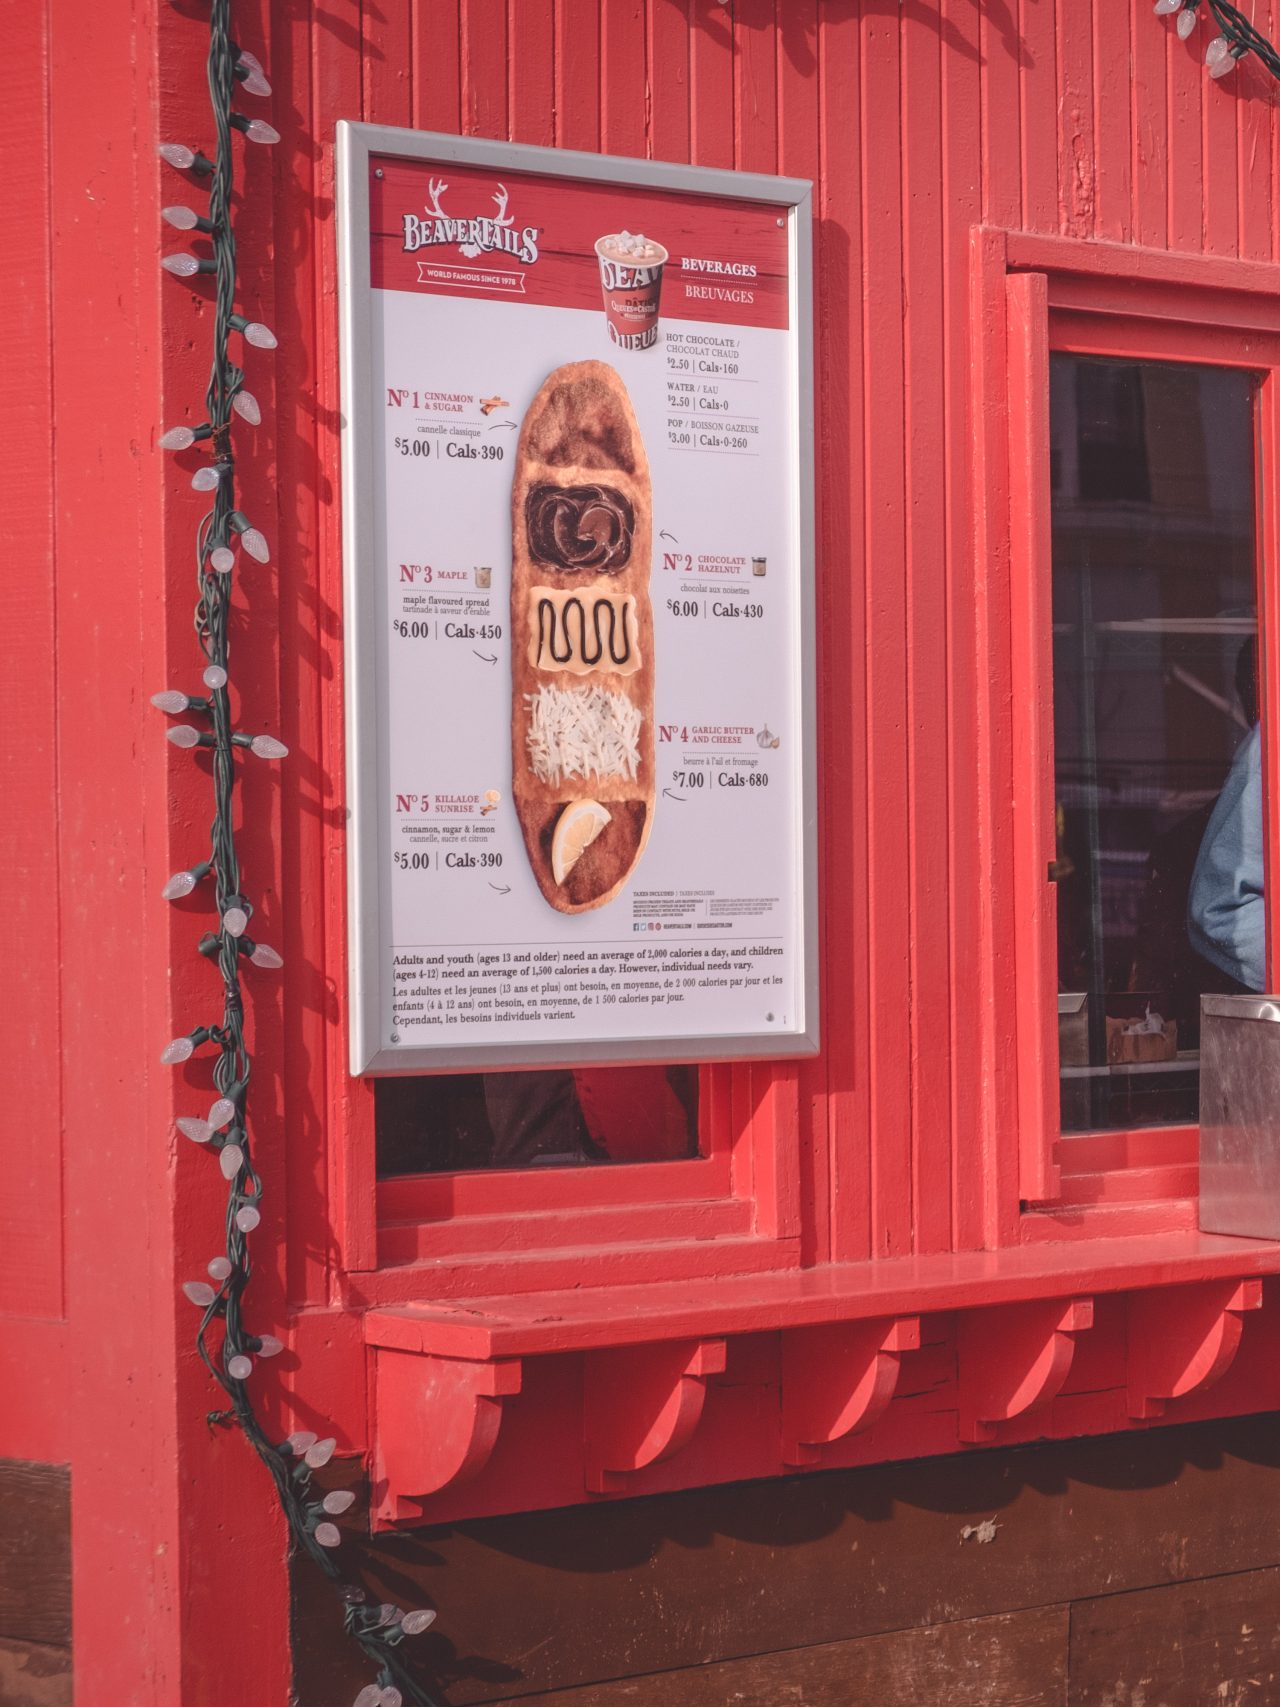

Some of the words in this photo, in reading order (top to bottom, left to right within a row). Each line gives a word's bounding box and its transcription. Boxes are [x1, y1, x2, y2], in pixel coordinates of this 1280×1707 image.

[681, 257, 757, 277] BEVERAGES
[427, 269, 452, 279] WORLD
[452, 272, 480, 282] FAMOUS
[481, 275, 500, 284] SINCE
[501, 278, 516, 286] 1978
[685, 284, 754, 304] BREUVAGES
[666, 333, 684, 342] HOT
[686, 336, 735, 348] CHOCOLATE
[666, 344, 710, 356] CHOCOLAT
[712, 349, 740, 359] CHAUD
[667, 356, 689, 370] $2.50
[667, 382, 695, 392] WATER
[703, 385, 718, 394] EAU
[412, 391, 420, 408] 1
[424, 392, 474, 404] CINNAMON
[668, 394, 690, 407] $2.50
[424, 402, 430, 410] &
[432, 402, 464, 412] SUGAR
[417, 424, 447, 434] cannelle
[448, 426, 481, 439] classique
[668, 418, 683, 428] POP
[691, 420, 723, 430] BOISSON
[726, 424, 759, 434] GAZEUSE
[668, 432, 690, 444] $3.00
[394, 436, 430, 457] $5.00
[685, 554, 692, 571] 2
[698, 555, 746, 565] CHOCOLATE
[424, 566, 432, 584] 3
[437, 571, 468, 580] MAPLE
[698, 564, 741, 574] HAZELNUT
[680, 583, 708, 593] chocolat
[709, 586, 721, 594] aux
[722, 587, 750, 595] noisettes
[403, 596, 426, 606] maple
[428, 596, 463, 606] flavoured
[465, 598, 490, 609] spread
[666, 598, 699, 617] $6.00
[402, 606, 432, 614] tartinade
[440, 608, 462, 616] saveur
[393, 619, 429, 638] $6.00
[680, 726, 688, 742] 4
[692, 726, 720, 734] GARLIC
[724, 726, 754, 735] BUTTER
[692, 736, 710, 744] AND
[711, 736, 742, 744] CHEESE
[683, 756, 705, 766] beurre
[732, 757, 759, 768] fromage
[672, 770, 704, 788] $7.00
[420, 794, 429, 812] 5
[435, 795, 480, 804] KILLALOE
[435, 804, 474, 813] SUNRISE
[402, 826, 440, 834] cinnamon,
[442, 826, 461, 836] sugar
[464, 826, 470, 834] &
[472, 825, 496, 834] lemon
[409, 834, 440, 844] cannelle,
[394, 850, 430, 870] $5.00
[392, 955, 424, 966] Adults
[426, 954, 444, 964] and
[447, 954, 474, 966] youth
[476, 953, 500, 965] (ages
[502, 953, 510, 962] 13
[514, 952, 530, 962] and
[533, 951, 560, 963] older)
[562, 951, 585, 962] need
[600, 952, 634, 962] average
[637, 950, 646, 959] of
[647, 950, 668, 960] 2,000
[670, 948, 702, 958] calories
[712, 948, 728, 959] day,
[730, 947, 747, 956] and
[748, 946, 784, 956] children
[392, 970, 416, 982] (ages
[418, 968, 439, 980] 4-12)
[442, 968, 465, 978] need
[468, 970, 480, 978] an
[482, 969, 518, 980] average
[520, 966, 530, 976] of
[532, 966, 552, 977] 1,500
[554, 965, 589, 975] calories
[599, 964, 616, 976] day.
[618, 963, 660, 974] However,
[662, 962, 705, 972] individual
[707, 960, 732, 970] needs
[734, 961, 754, 972] vary.
[392, 987, 408, 997] Les
[410, 986, 442, 996] adultes
[444, 987, 452, 996] et
[454, 985, 467, 995] les
[468, 986, 497, 997] jeunes
[500, 984, 511, 995] (13
[530, 984, 538, 993] et
[541, 982, 560, 994] plus)
[564, 983, 578, 991] ont
[580, 981, 608, 992] besoin,
[623, 982, 662, 992] moyenne,
[664, 979, 674, 988] de
[698, 977, 728, 987] calories
[730, 979, 742, 989] par
[744, 977, 760, 988] jour
[762, 977, 770, 985] et
[772, 976, 783, 984] les
[392, 1001, 424, 1011] enfants
[426, 1000, 434, 1012] (4
[438, 1000, 442, 1009] à
[446, 1000, 455, 1009] 12
[458, 998, 475, 1010] ans)
[478, 1000, 492, 1009] ont
[494, 998, 524, 1009] besoin,
[540, 998, 580, 1009] moyenne,
[582, 996, 593, 1005] de
[618, 994, 650, 1004] calories
[652, 995, 664, 1005] par
[666, 993, 684, 1004] jour.
[392, 1015, 443, 1028] Cependant,
[446, 1014, 458, 1024] les
[460, 1013, 492, 1023] besoins
[494, 1010, 542, 1022] individuels
[544, 1010, 576, 1020] varient.
